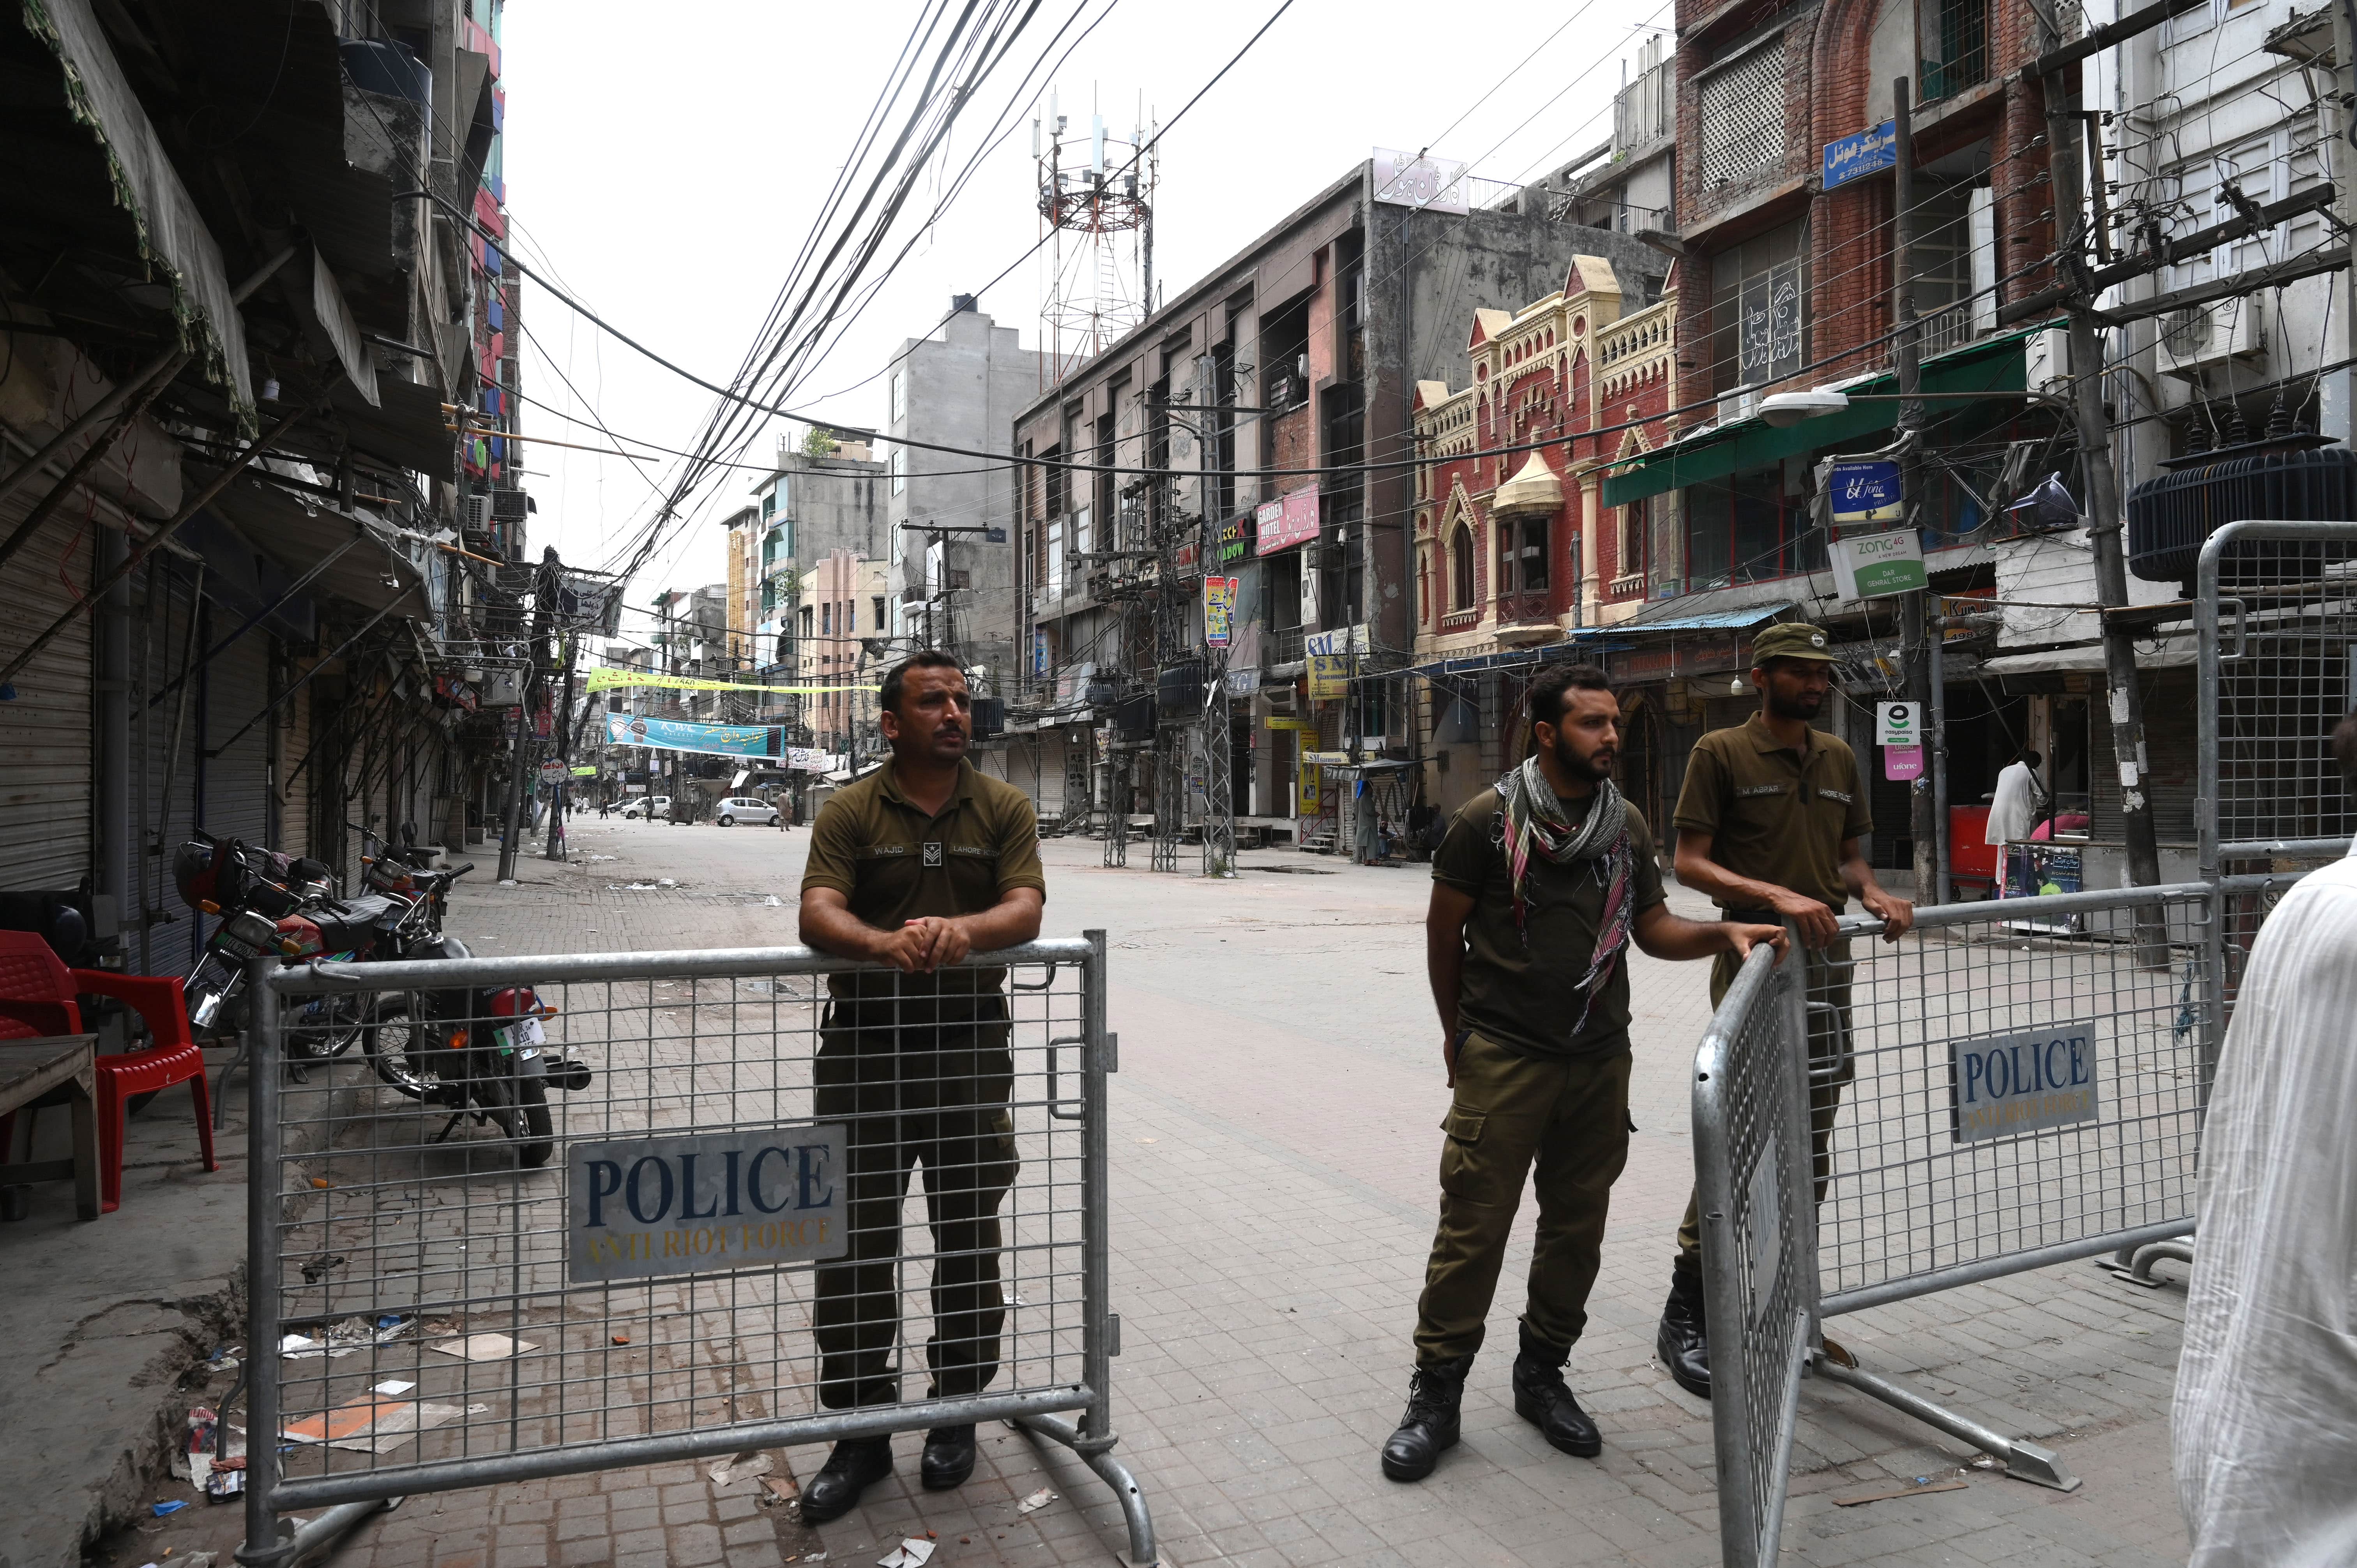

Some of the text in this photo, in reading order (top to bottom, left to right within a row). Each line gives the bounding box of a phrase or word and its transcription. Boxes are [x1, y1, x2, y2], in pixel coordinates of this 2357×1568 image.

[1258, 502, 1283, 525] GARDEN
[1261, 520, 1280, 540] HOTEL
[1894, 537, 1904, 545] 4G
[1867, 574, 1912, 587] GENRAL STORE
[1308, 634, 1332, 657] SM
[1631, 651, 1681, 671] KILLANI
[739, 727, 764, 747] خواجہ
[1820, 788, 1851, 802] LAHORE POLICE
[875, 846, 904, 855] WAJID
[219, 948, 242, 962] HONDA
[1963, 1037, 2089, 1103] POLICE
[1968, 1090, 2089, 1129] ANTI RIOT FORCE
[583, 1144, 832, 1228] POLICE
[588, 1217, 832, 1264] ANTI RIOT FORCE
